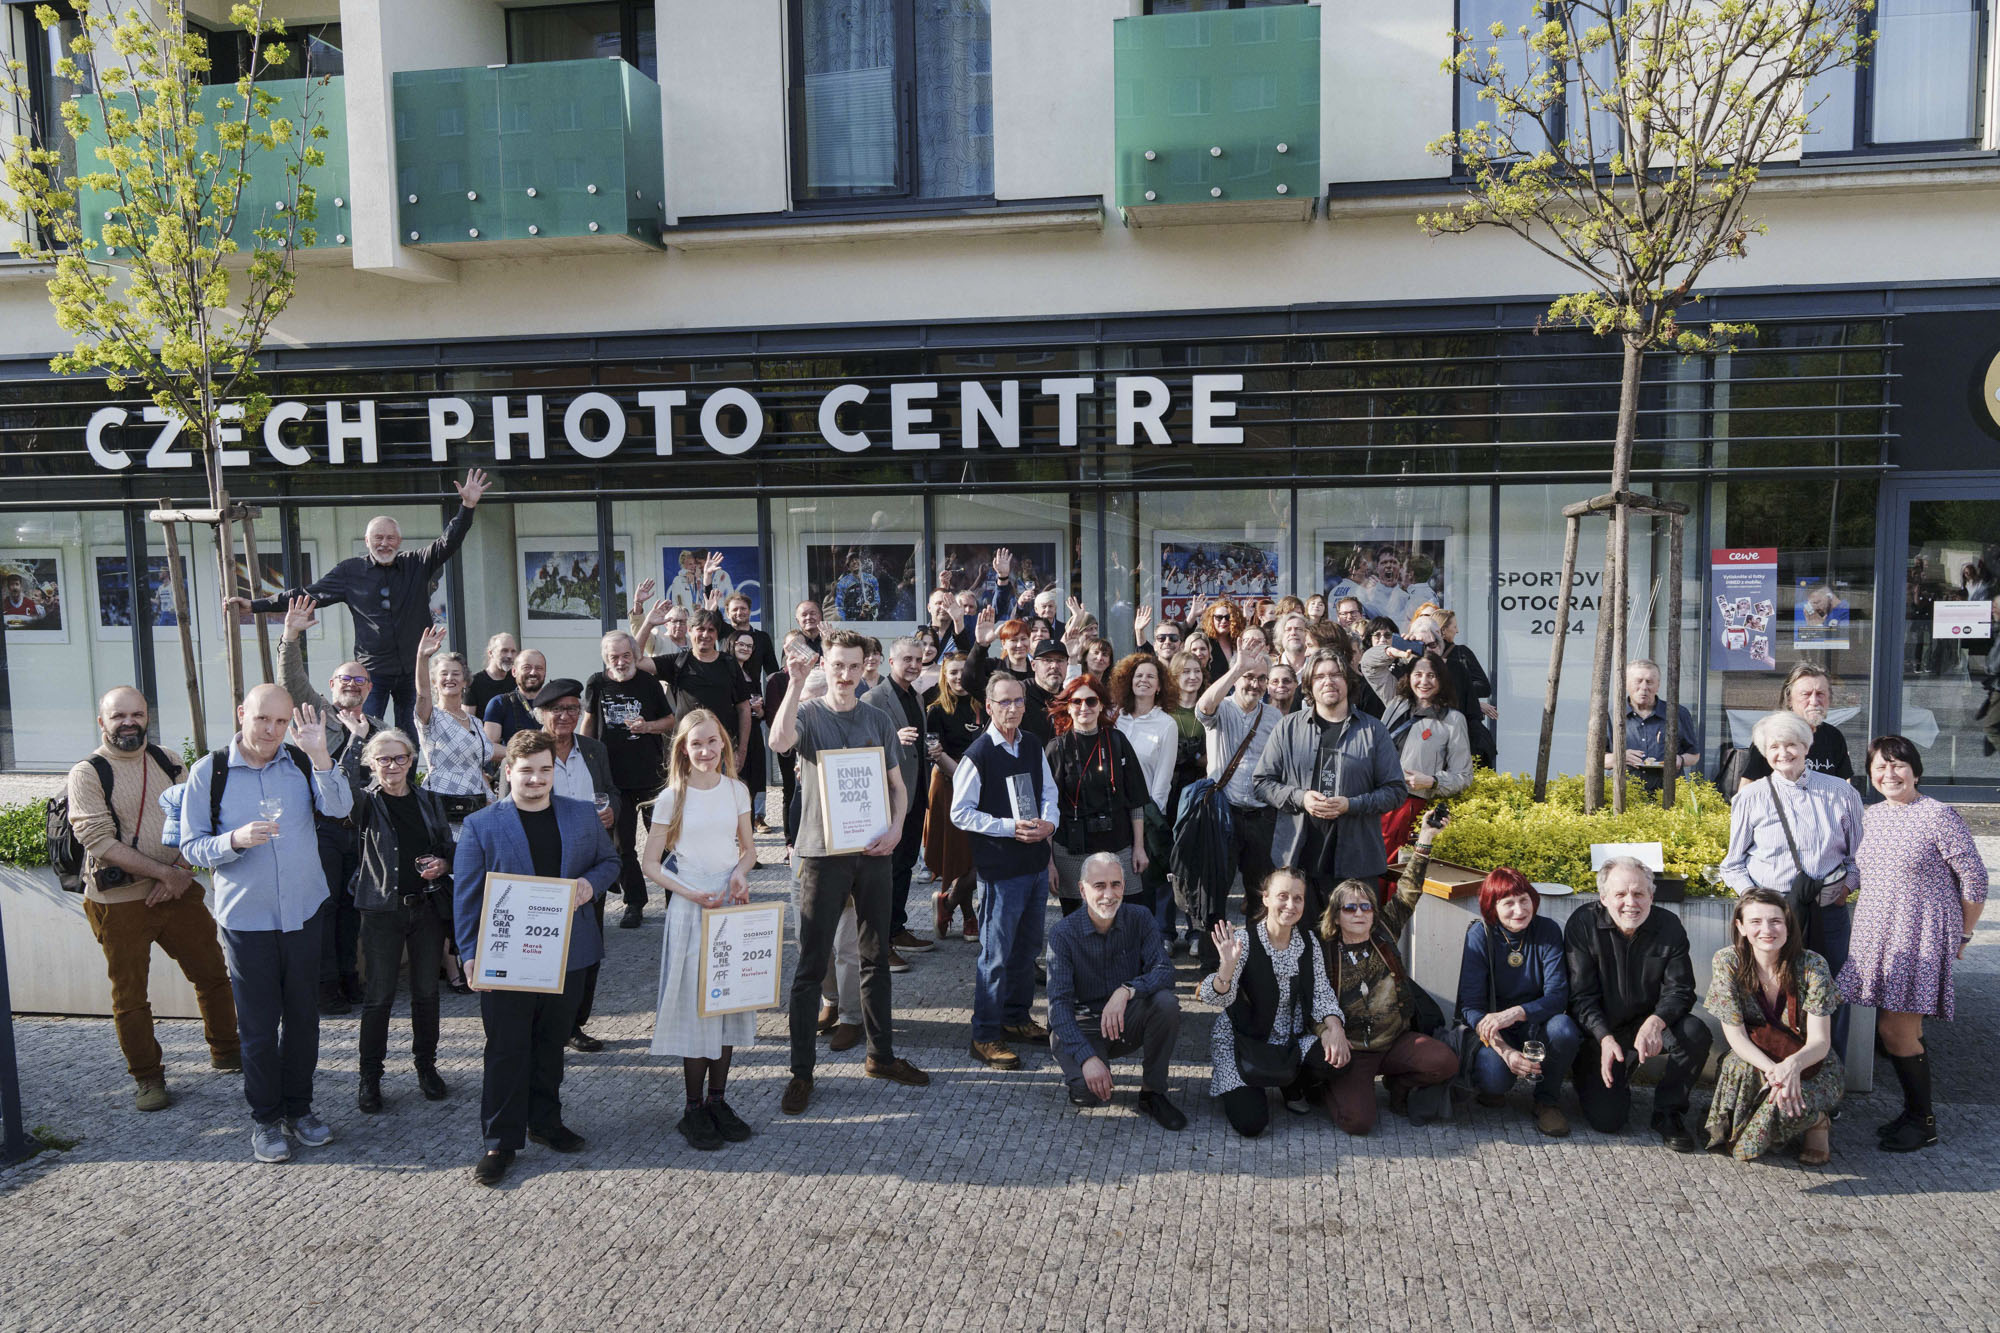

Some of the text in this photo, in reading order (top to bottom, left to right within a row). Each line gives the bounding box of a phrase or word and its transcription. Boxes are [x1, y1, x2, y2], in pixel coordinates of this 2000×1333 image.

[86, 374, 1244, 470] CZECH PHOTO CENTRE
[1728, 551, 1760, 561] cewe
[837, 766, 873, 778] KNIHA
[838, 777, 870, 790] ROKU
[840, 790, 869, 803] 2024
[528, 905, 563, 913] OSOBNOST
[493, 913, 515, 921] FOTO
[493, 920, 510, 928] GRA
[498, 927, 509, 935] FIE
[525, 925, 559, 938] 2024
[743, 930, 773, 938] OSOBNOST
[713, 951, 729, 959] GRA
[742, 949, 772, 961] 2024
[719, 957, 729, 965] FIE
